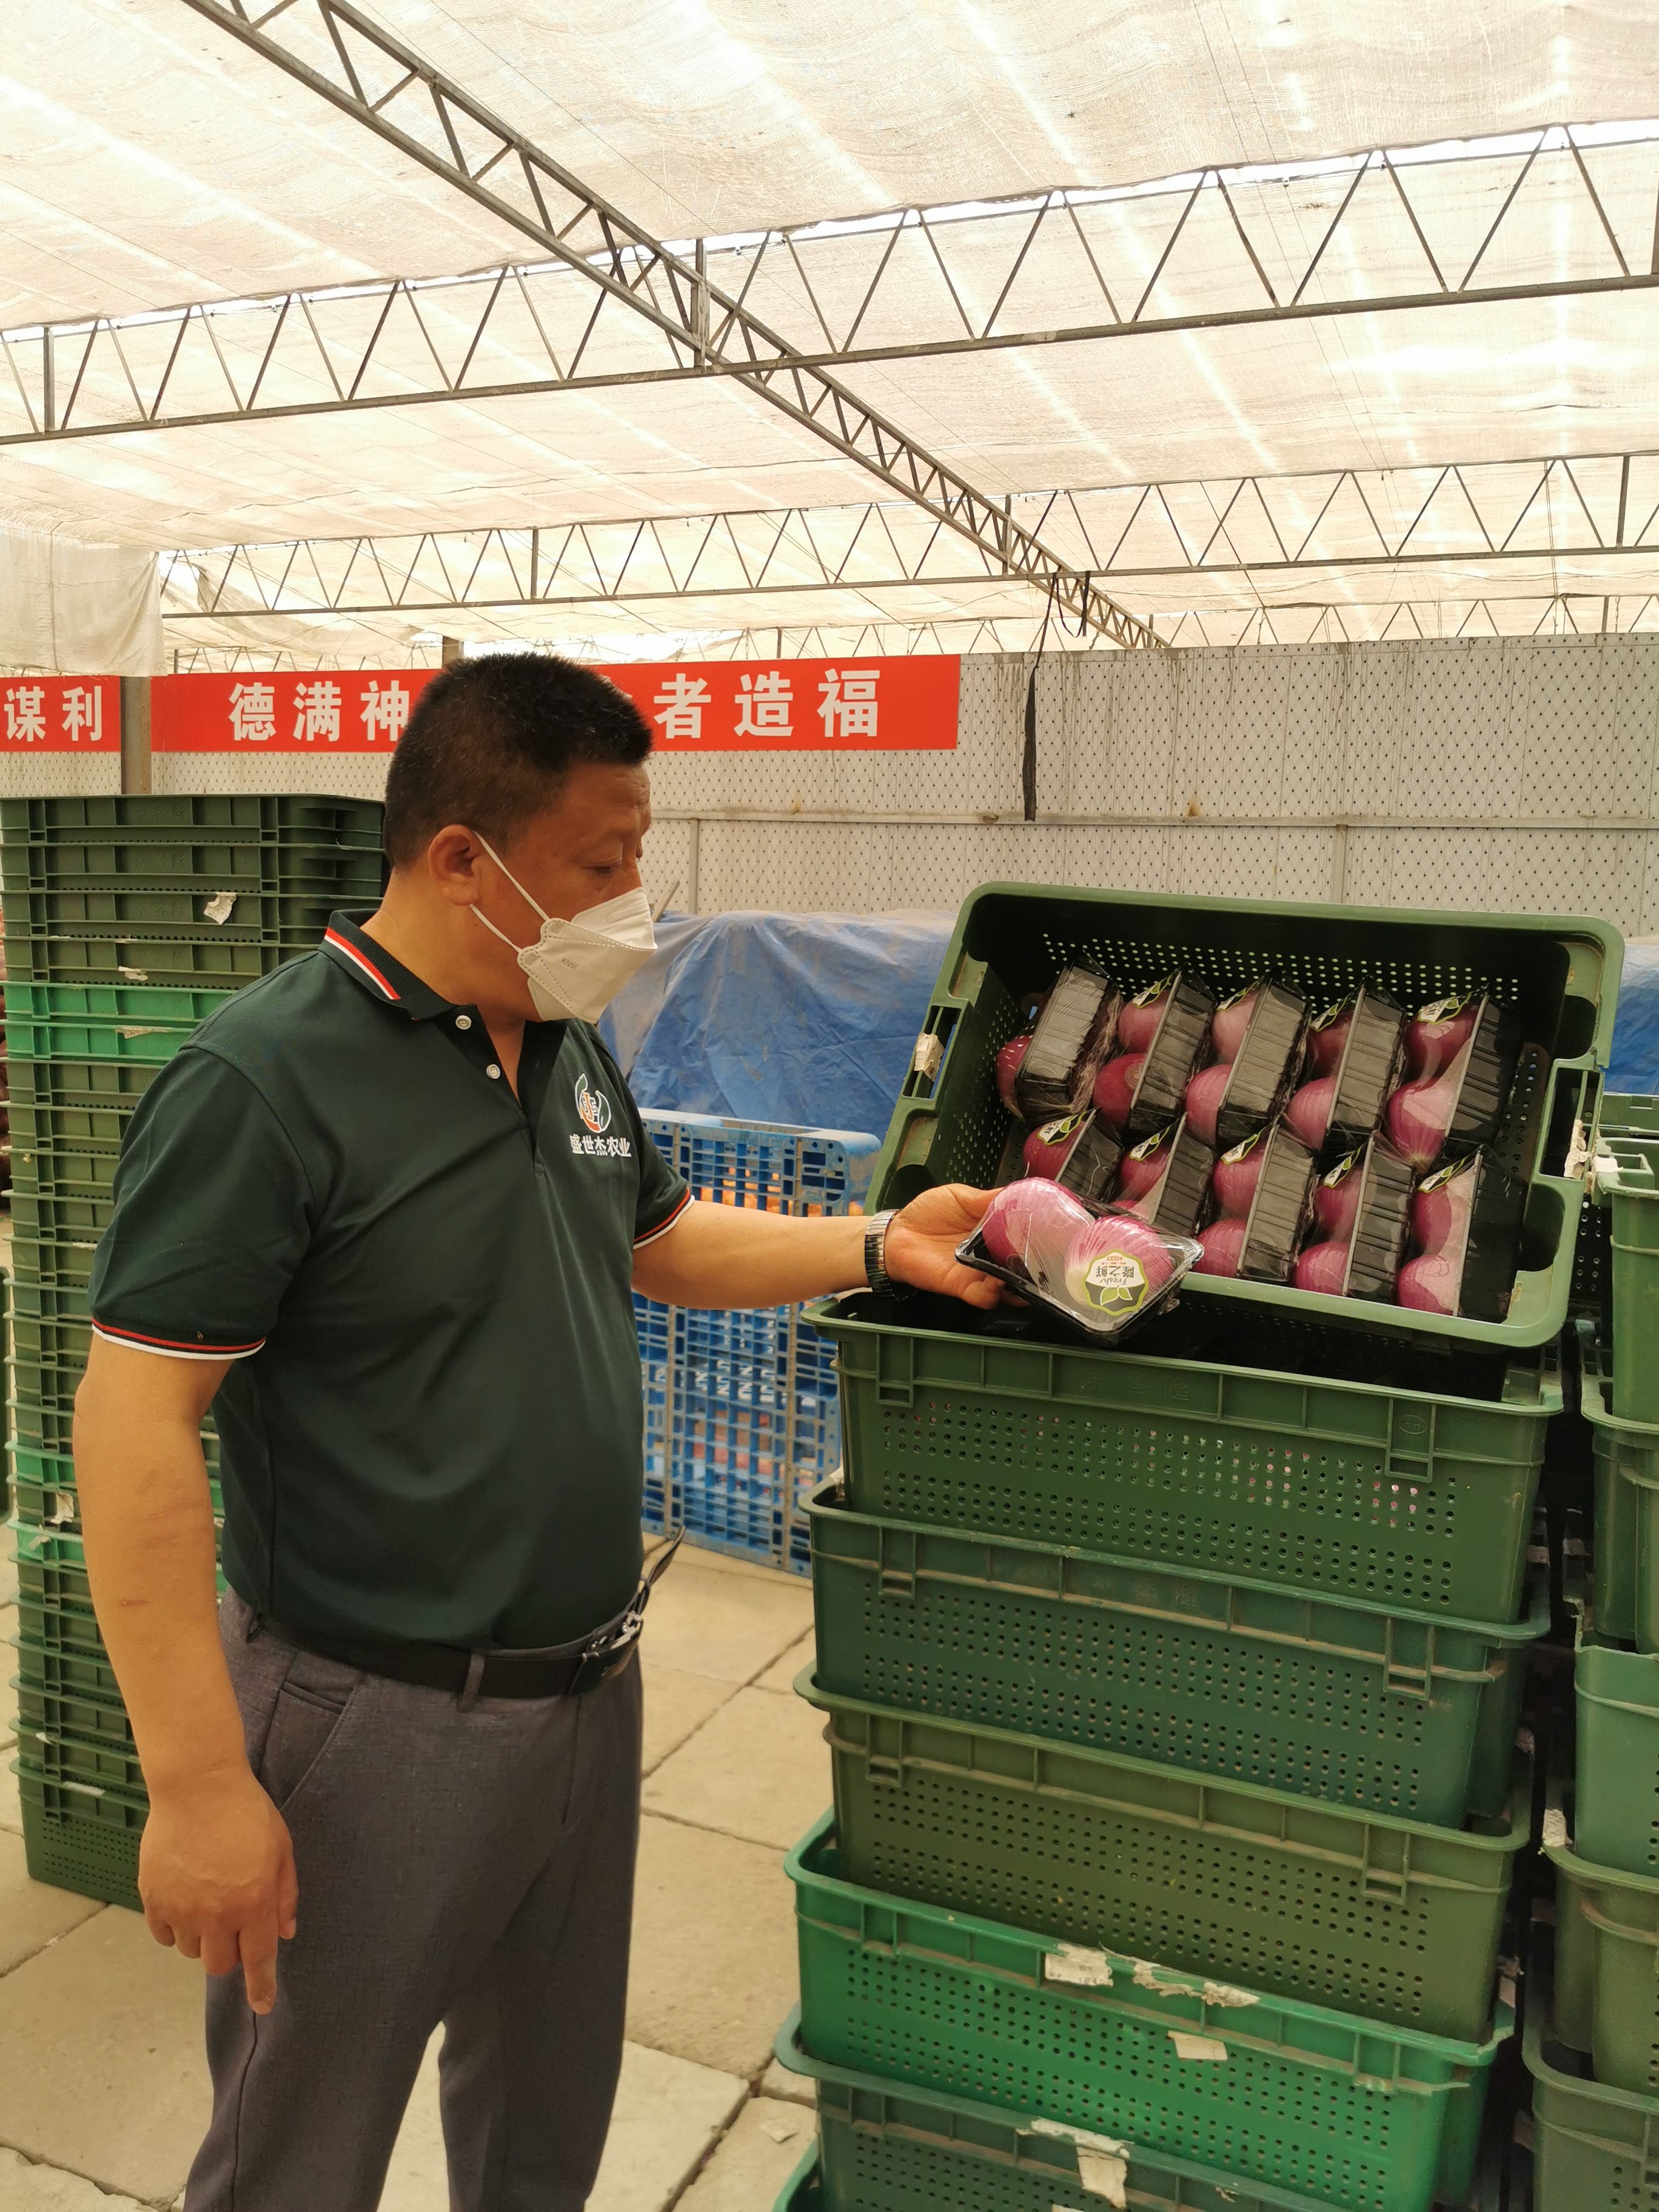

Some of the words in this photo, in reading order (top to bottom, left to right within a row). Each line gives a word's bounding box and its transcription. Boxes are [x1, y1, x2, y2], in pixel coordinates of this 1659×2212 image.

[4, 685, 102, 742] 谋利
[229, 680, 411, 742] 德满神
[653, 668, 880, 739] 者造福
[569, 1133, 632, 1158] 盛世杰农业
[1100, 1277, 1127, 1285] Fresh
